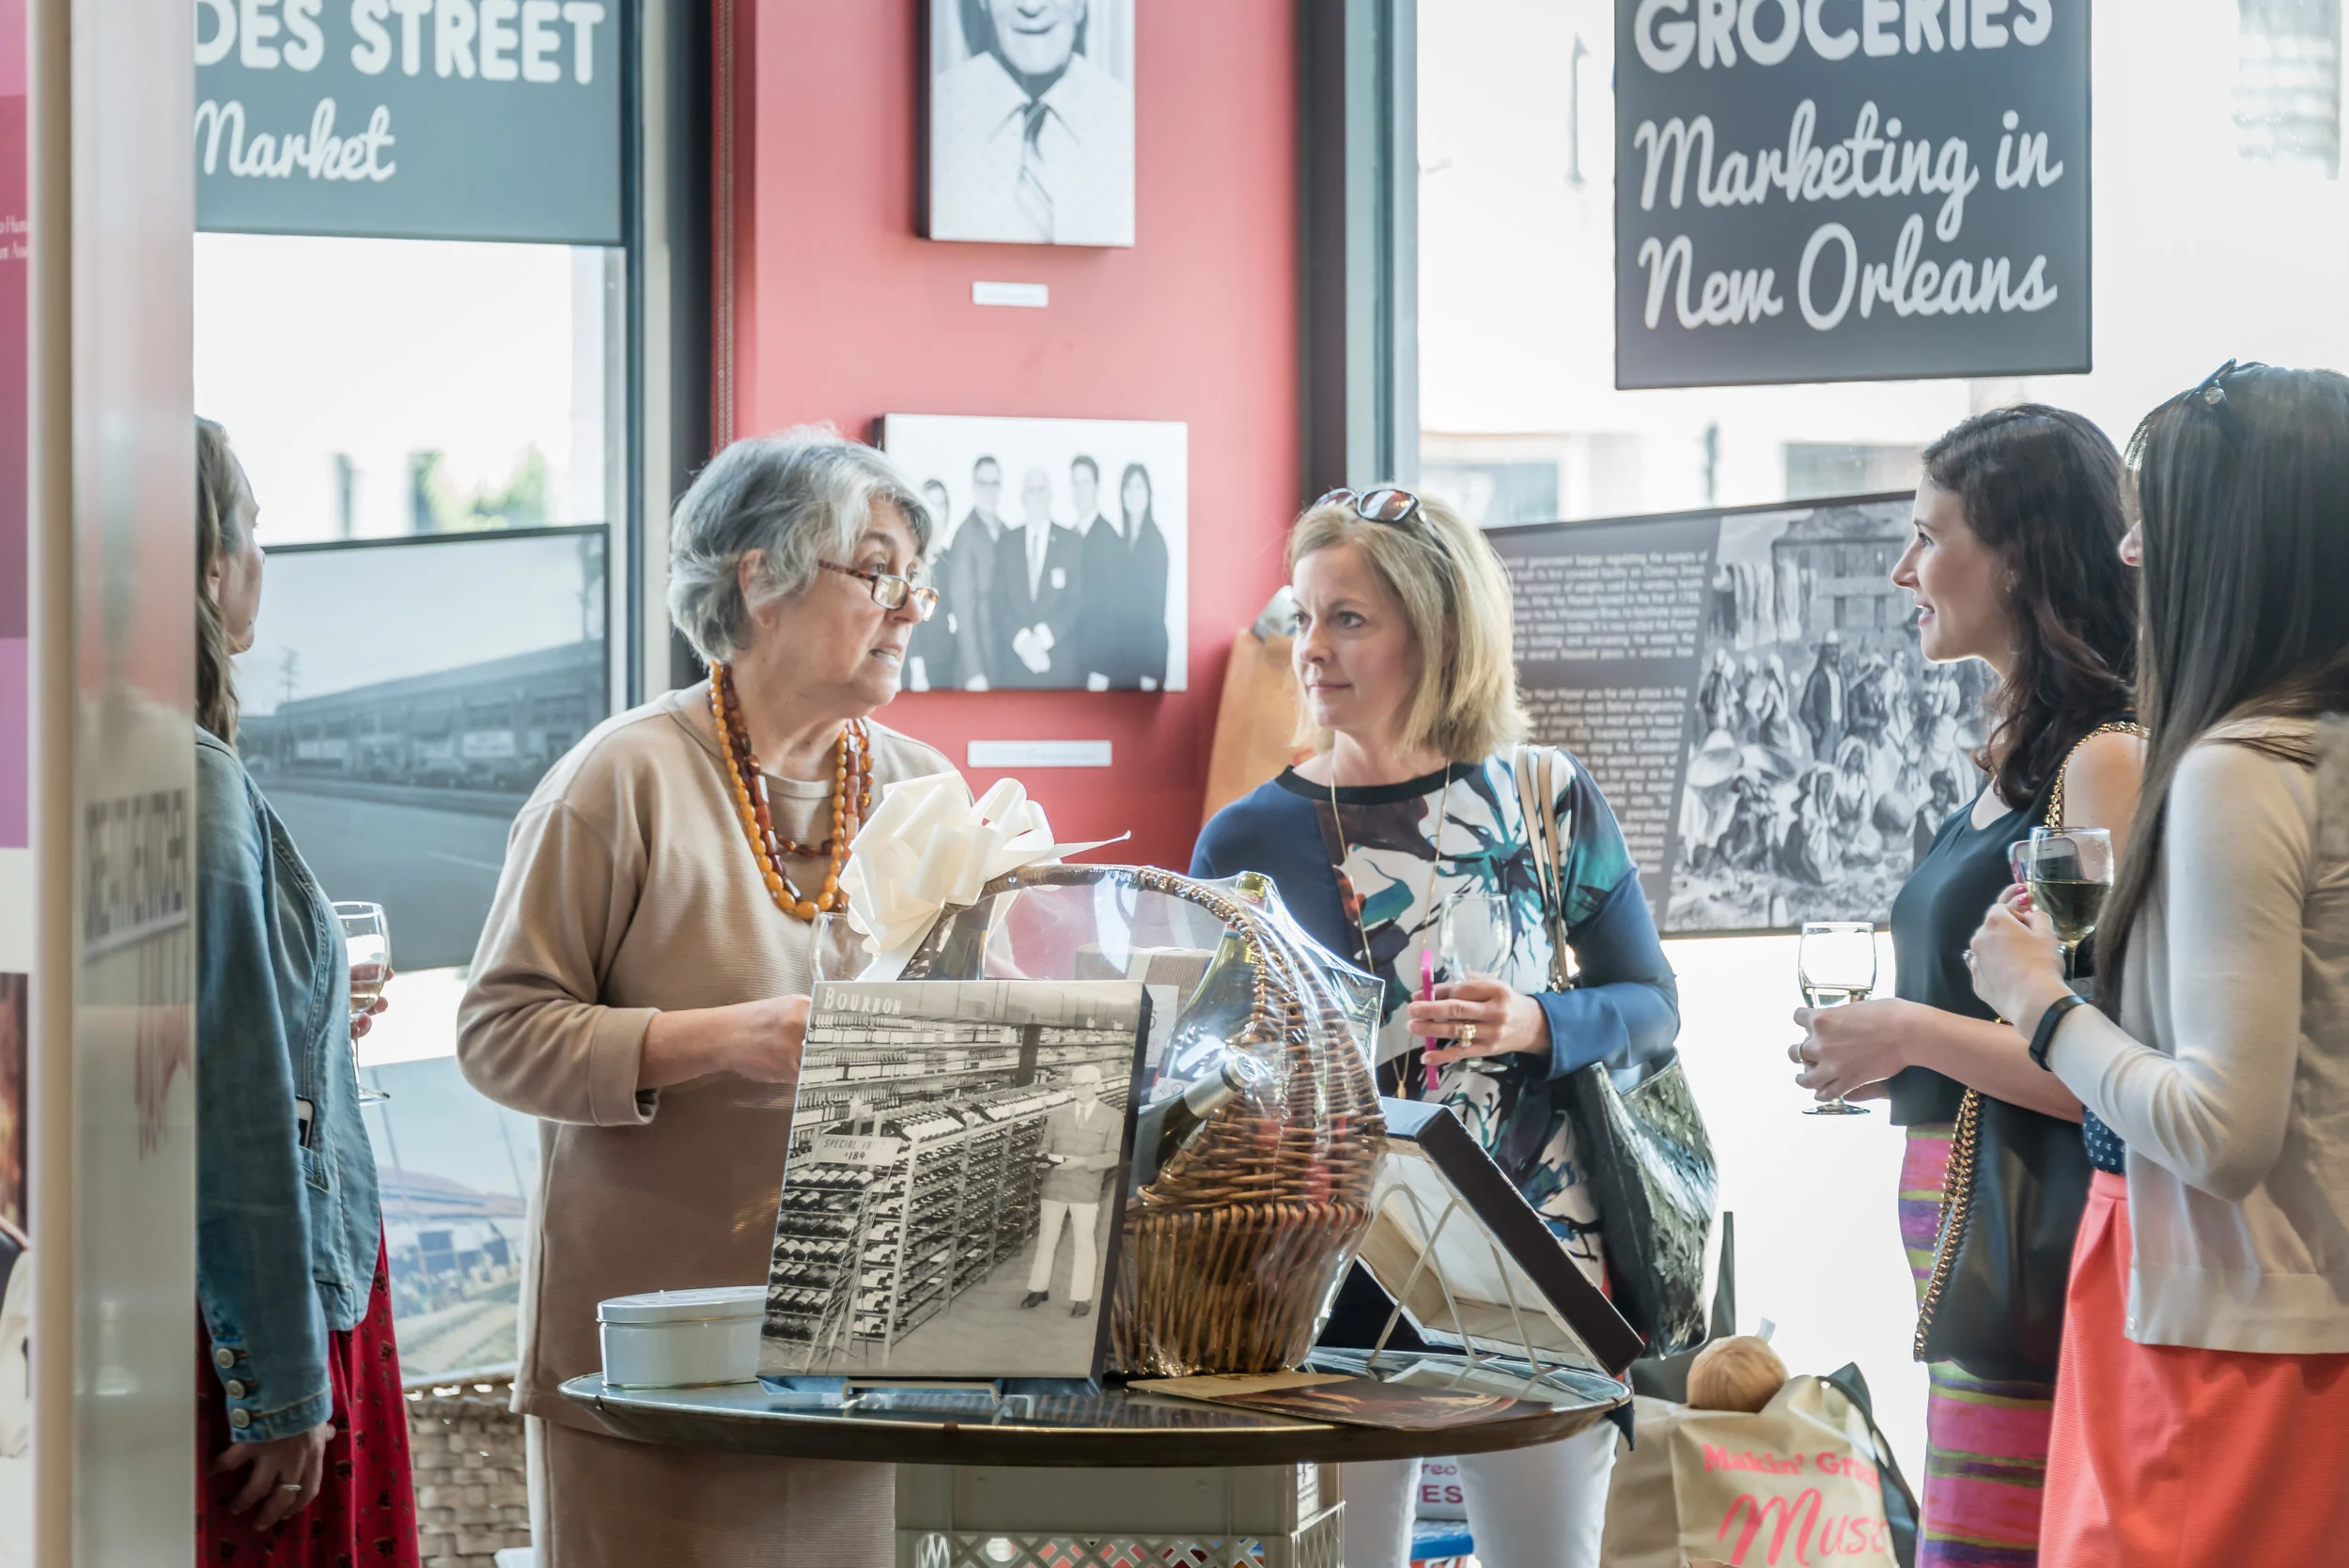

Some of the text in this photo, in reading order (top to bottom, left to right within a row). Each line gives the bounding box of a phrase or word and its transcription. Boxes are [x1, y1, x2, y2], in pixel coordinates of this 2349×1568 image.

[350, 0, 606, 85] STREET
[1633, 0, 2053, 73] GROCERIES
[194, 97, 397, 182] Market
[1634, 98, 2063, 242] Marketing in
[1638, 213, 2058, 331] New Orleans
[1417, 1483, 1464, 1505] ES
[1701, 1443, 1803, 1475] Makin'
